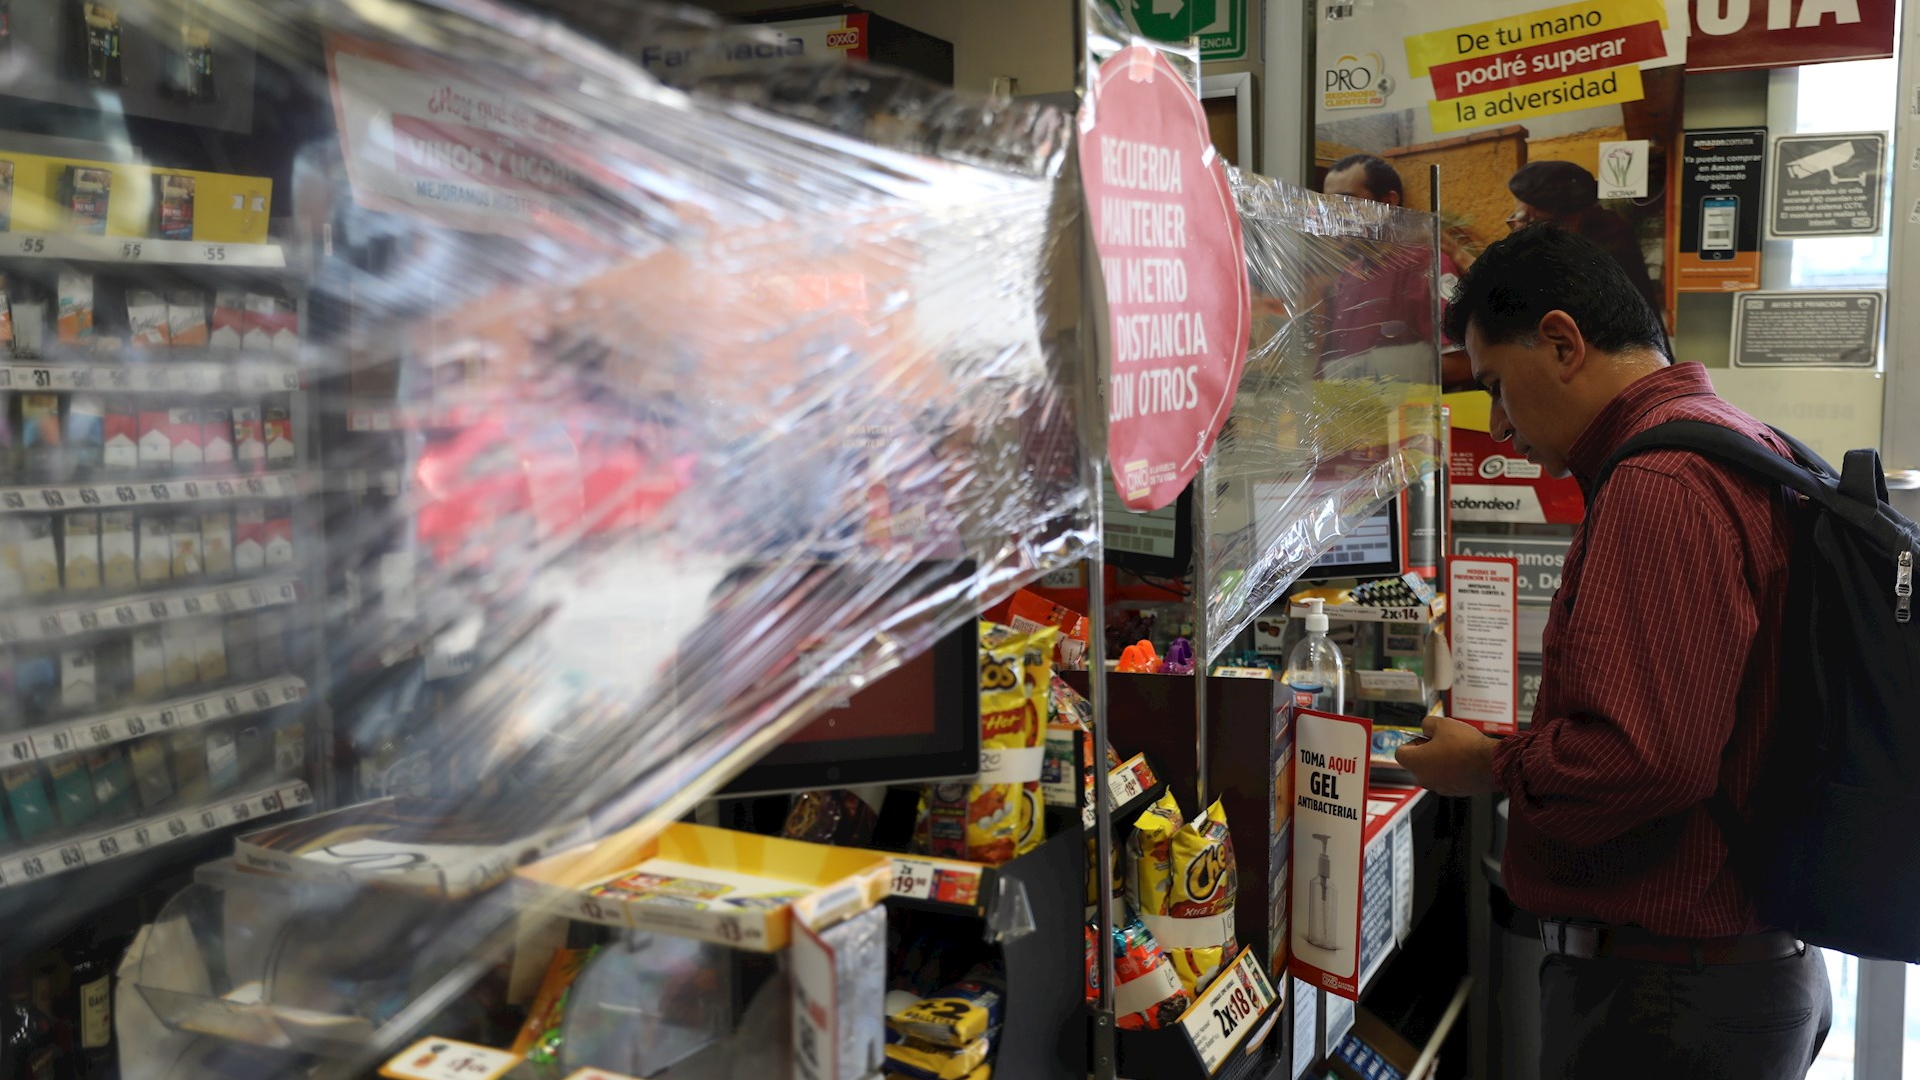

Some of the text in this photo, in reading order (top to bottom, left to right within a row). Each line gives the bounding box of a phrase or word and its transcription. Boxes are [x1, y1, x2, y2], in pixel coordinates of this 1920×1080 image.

[827, 32, 858, 48] OXXO
[1201, 37, 1232, 48] ENCIA
[1456, 10, 1602, 55] De tu mano
[641, 33, 806, 68] Faracia
[1455, 36, 1626, 92] podré superar
[1325, 67, 1371, 92] PRO
[1325, 90, 1377, 100] REDONDEO
[1325, 98, 1369, 108] CLIENTES
[1456, 71, 1618, 123] la adversidad
[1101, 134, 1183, 194] RECUERDA
[1101, 196, 1187, 249] MANTENER
[1127, 257, 1187, 304] METRO
[1116, 312, 1208, 363] DISTANCIA
[1138, 365, 1199, 417] OTROS
[1452, 497, 1521, 511] edondeo!
[1539, 573, 1562, 589] Dé
[1300, 748, 1357, 775] TOMA AQUÍ
[1310, 771, 1339, 801] GEL
[1297, 795, 1358, 821] ANTIBACTERIAL
[1187, 843, 1227, 902] Che
